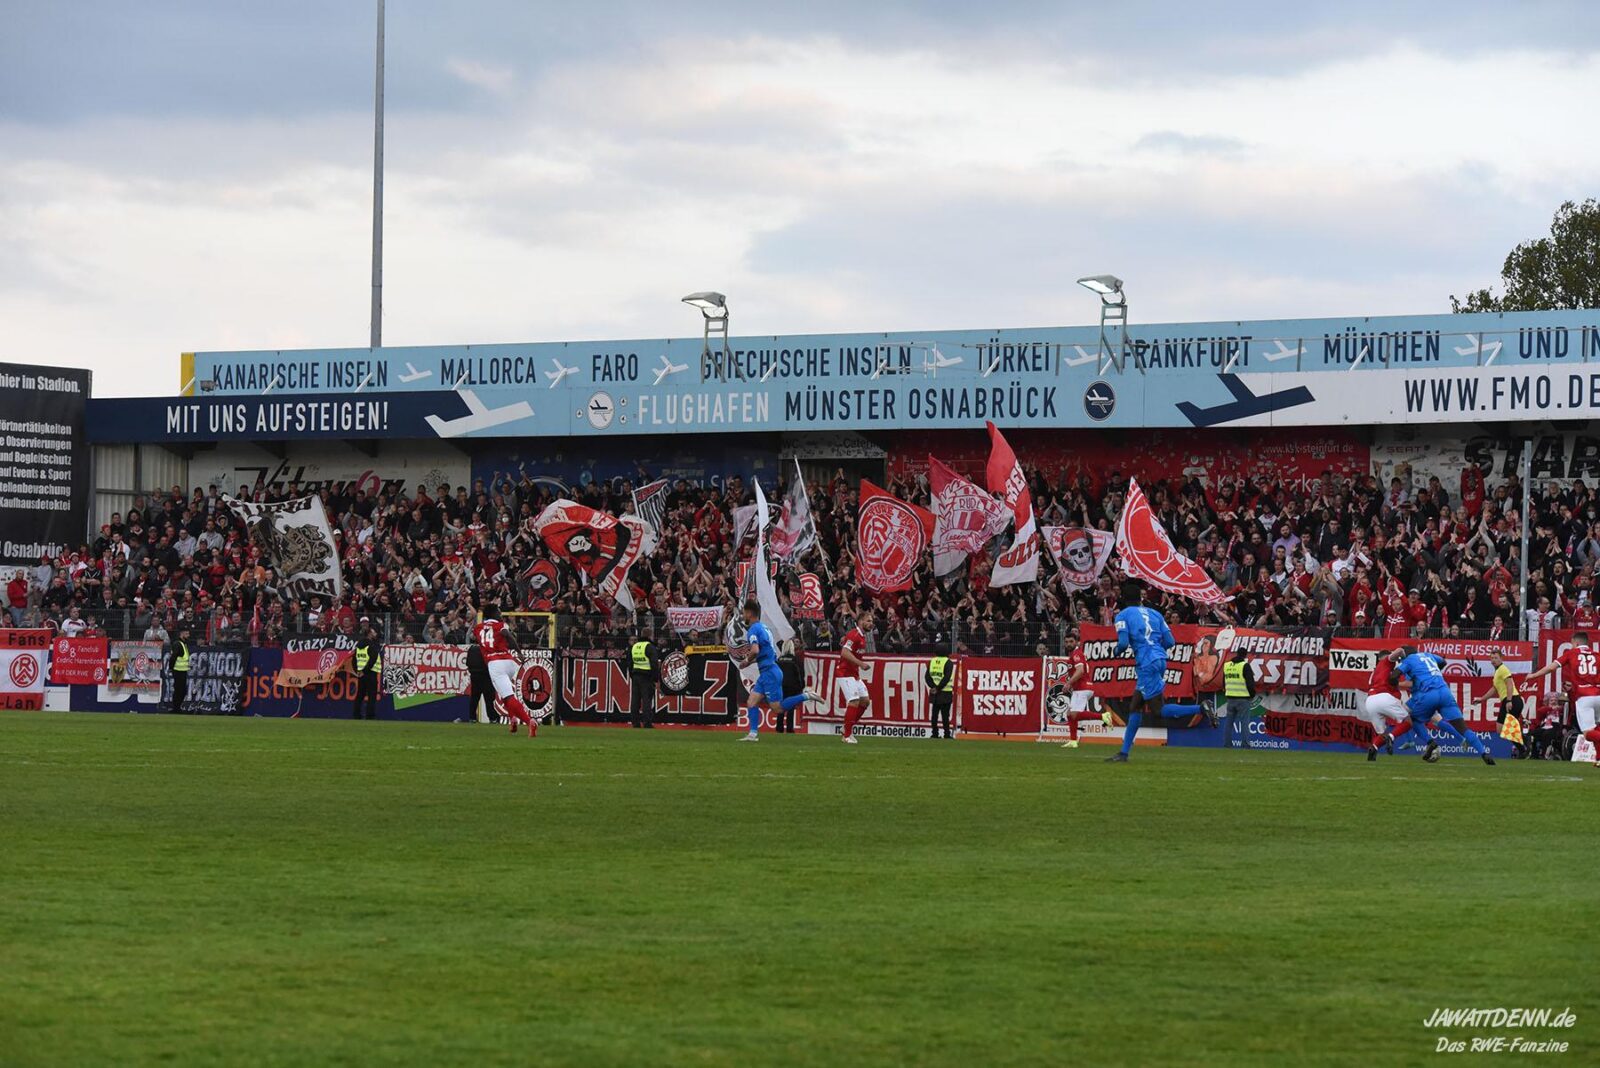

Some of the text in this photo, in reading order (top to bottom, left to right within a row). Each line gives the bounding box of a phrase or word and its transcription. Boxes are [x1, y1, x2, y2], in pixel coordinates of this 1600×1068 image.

[1123, 336, 1252, 369] FRANKFURT
[1324, 327, 1440, 364] MÜNCHEN
[1519, 327, 1569, 359] UND
[702, 346, 911, 380] GRIECHISCHE INSELN
[975, 338, 1050, 373] TÜRKEI
[213, 360, 388, 390] KANARISCHE INSELN
[440, 357, 536, 385] MALLORCA
[592, 353, 638, 382] FARO
[0, 373, 81, 393] hier im Stadion.
[1405, 374, 1600, 412] WWW.FMO.DE
[638, 381, 1057, 425] FLUGHAFEN MÜNSTER OSNABRÜCK
[166, 401, 389, 433] MIT UNS AUFSTEIGEN!
[6, 435, 72, 450] Observierungen
[14, 451, 72, 465] Begleitschutz
[13, 466, 39, 479] Events
[40, 469, 47, 480] &
[48, 468, 72, 481] Sport
[4, 540, 63, 559] Osnabrüc
[8, 632, 46, 647] Fans
[479, 625, 495, 649] 14
[389, 648, 468, 670] WRECKING
[1331, 651, 1369, 669] West
[1423, 642, 1462, 656] WAHRE
[1093, 667, 1114, 683] ROT
[1250, 658, 1317, 685] SSEN
[1577, 654, 1598, 676] 32
[416, 671, 459, 690] CREW
[883, 661, 956, 722] FAN
[967, 670, 1034, 692] FREAKS
[973, 694, 1027, 716] ESSEN
[835, 723, 926, 738] morrad-boegel.de
